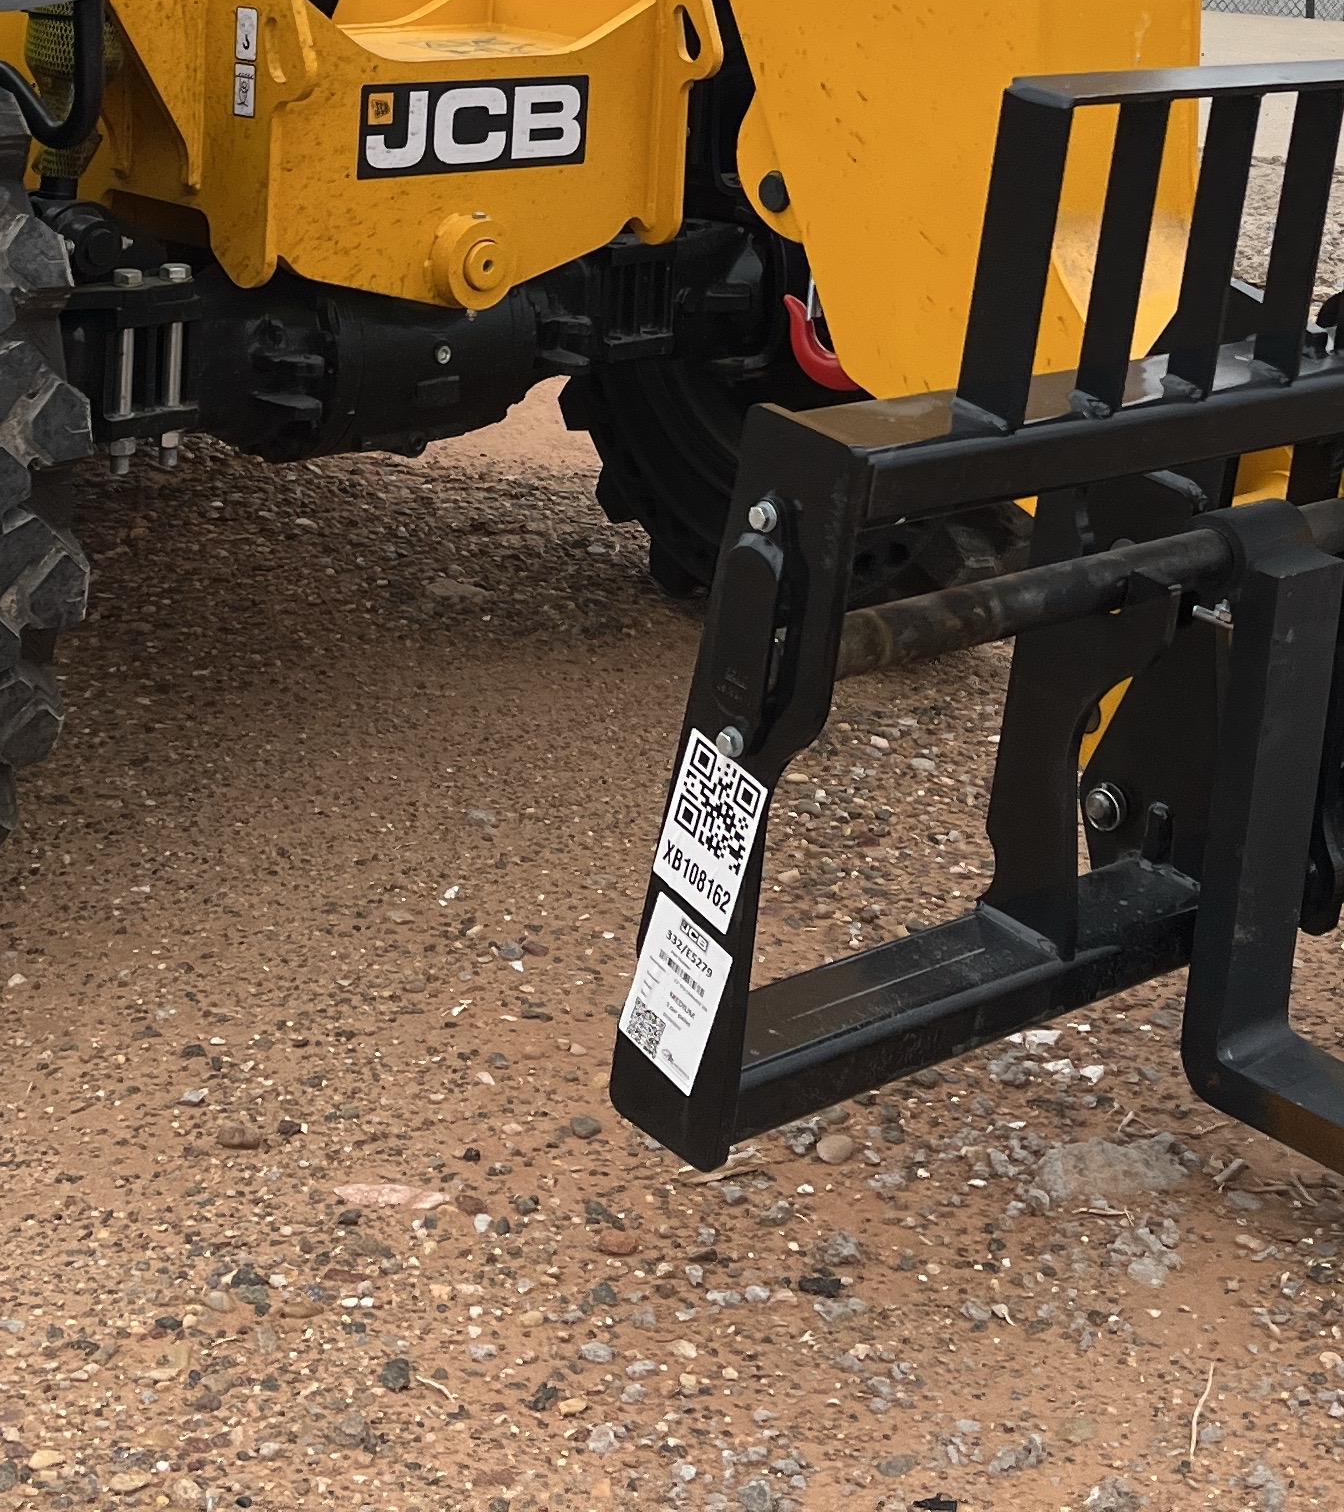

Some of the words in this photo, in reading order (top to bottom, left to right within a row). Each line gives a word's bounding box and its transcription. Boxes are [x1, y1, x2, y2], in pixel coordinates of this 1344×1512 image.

[365, 84, 581, 169] JCB
[662, 838, 732, 915] XB108162
[680, 919, 709, 952] JCB
